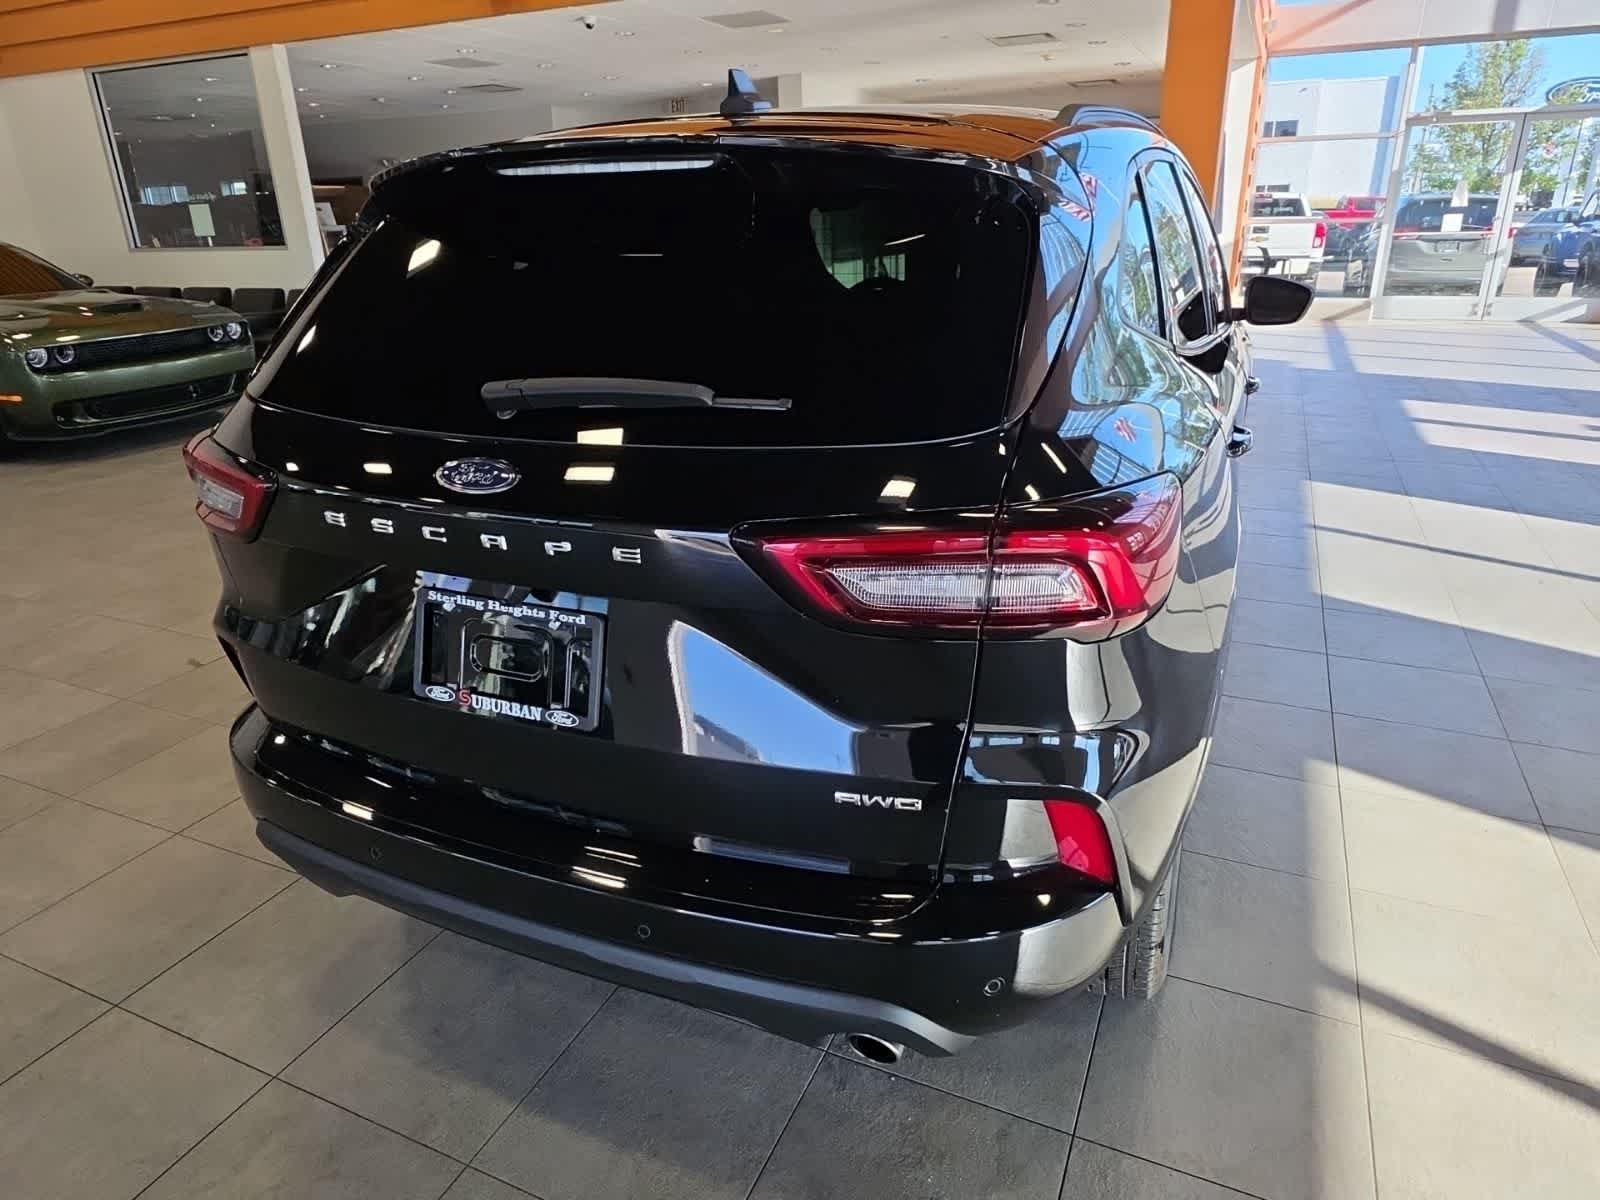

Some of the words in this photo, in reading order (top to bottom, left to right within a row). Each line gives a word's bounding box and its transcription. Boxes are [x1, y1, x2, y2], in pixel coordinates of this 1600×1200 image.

[323, 510, 642, 563] ESCAPE
[427, 590, 485, 611] Sterling
[487, 599, 546, 617] Heights
[548, 609, 586, 625] Ford
[459, 689, 543, 721] SUBURBAN
[834, 791, 922, 811] AWD
